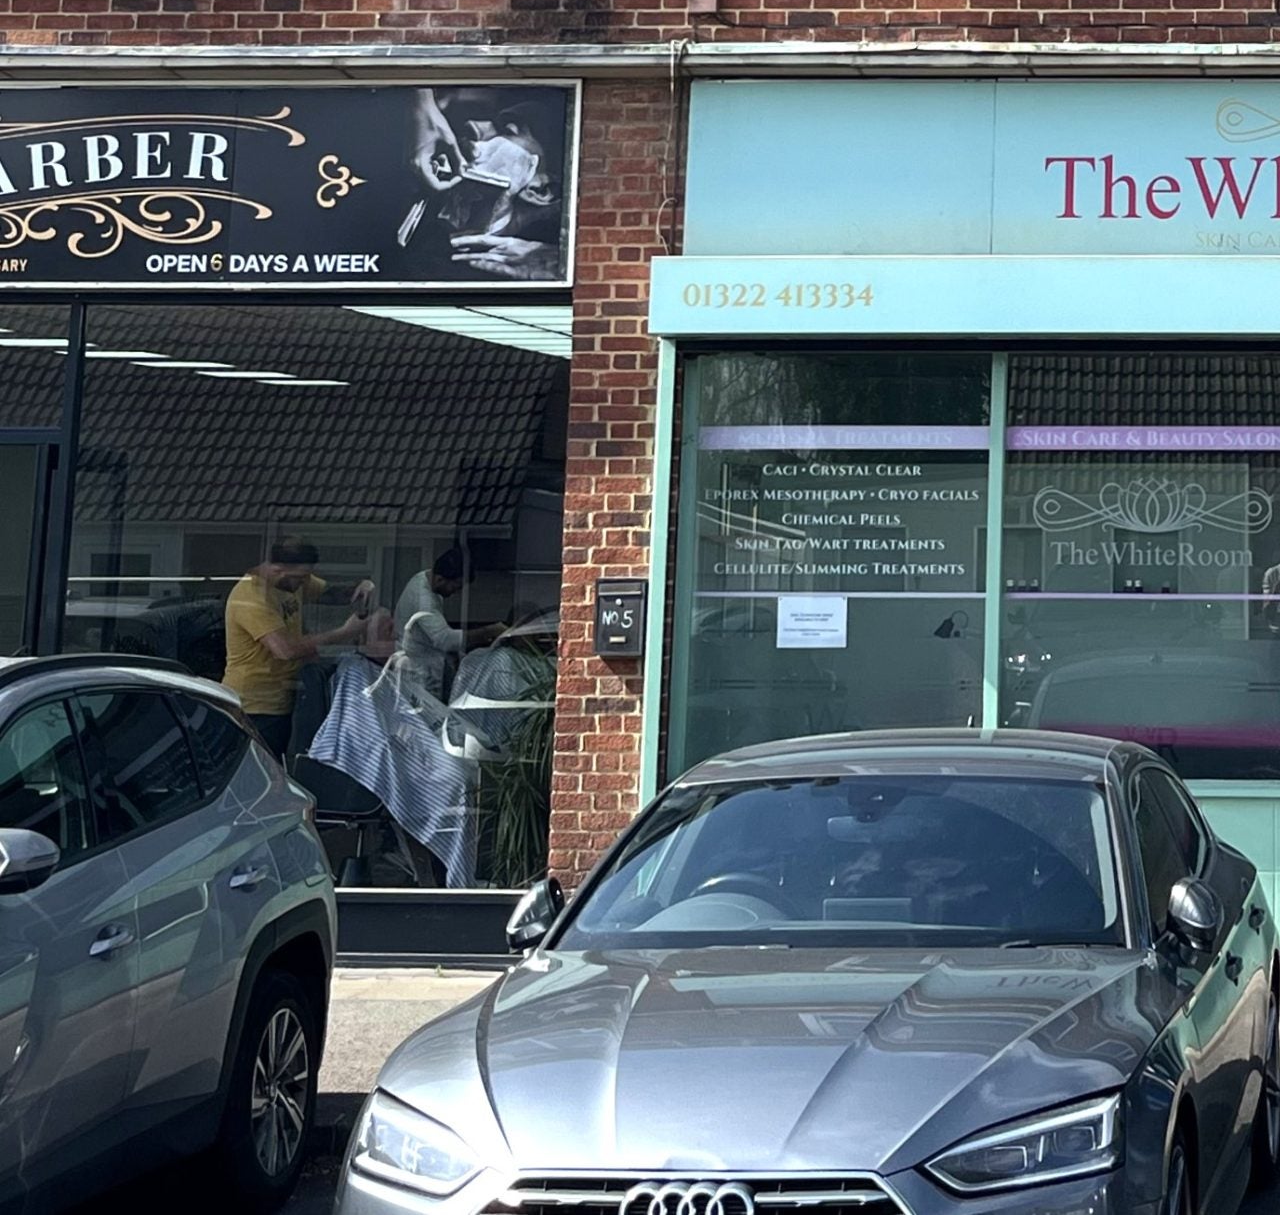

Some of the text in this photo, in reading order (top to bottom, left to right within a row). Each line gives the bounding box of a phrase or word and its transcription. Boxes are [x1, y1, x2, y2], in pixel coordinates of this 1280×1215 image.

[0, 258, 28, 272] ARY
[145, 253, 379, 273] OPEN 6 DAYS A WEEK
[682, 283, 875, 308] 01322 413334
[1021, 430, 1067, 446] SKIN
[1072, 430, 1121, 446] CARE
[1126, 430, 1142, 446] &
[1147, 431, 1218, 446] BEAUTY
[762, 463, 922, 477] CACI CRYSTAL CLEAR
[763, 489, 866, 502] MESOTHERAPY
[877, 489, 919, 502] CRYO
[922, 489, 980, 502] FACIALS
[781, 513, 901, 526] CHEMICAL PEELS
[734, 537, 771, 550] SKIN
[854, 537, 945, 551] TREATMENTS
[1050, 541, 1253, 567] TheWhiteRoom
[713, 562, 965, 576] CELLULITE/SLIMMING TREATMENTS
[620, 609, 634, 628] 5
